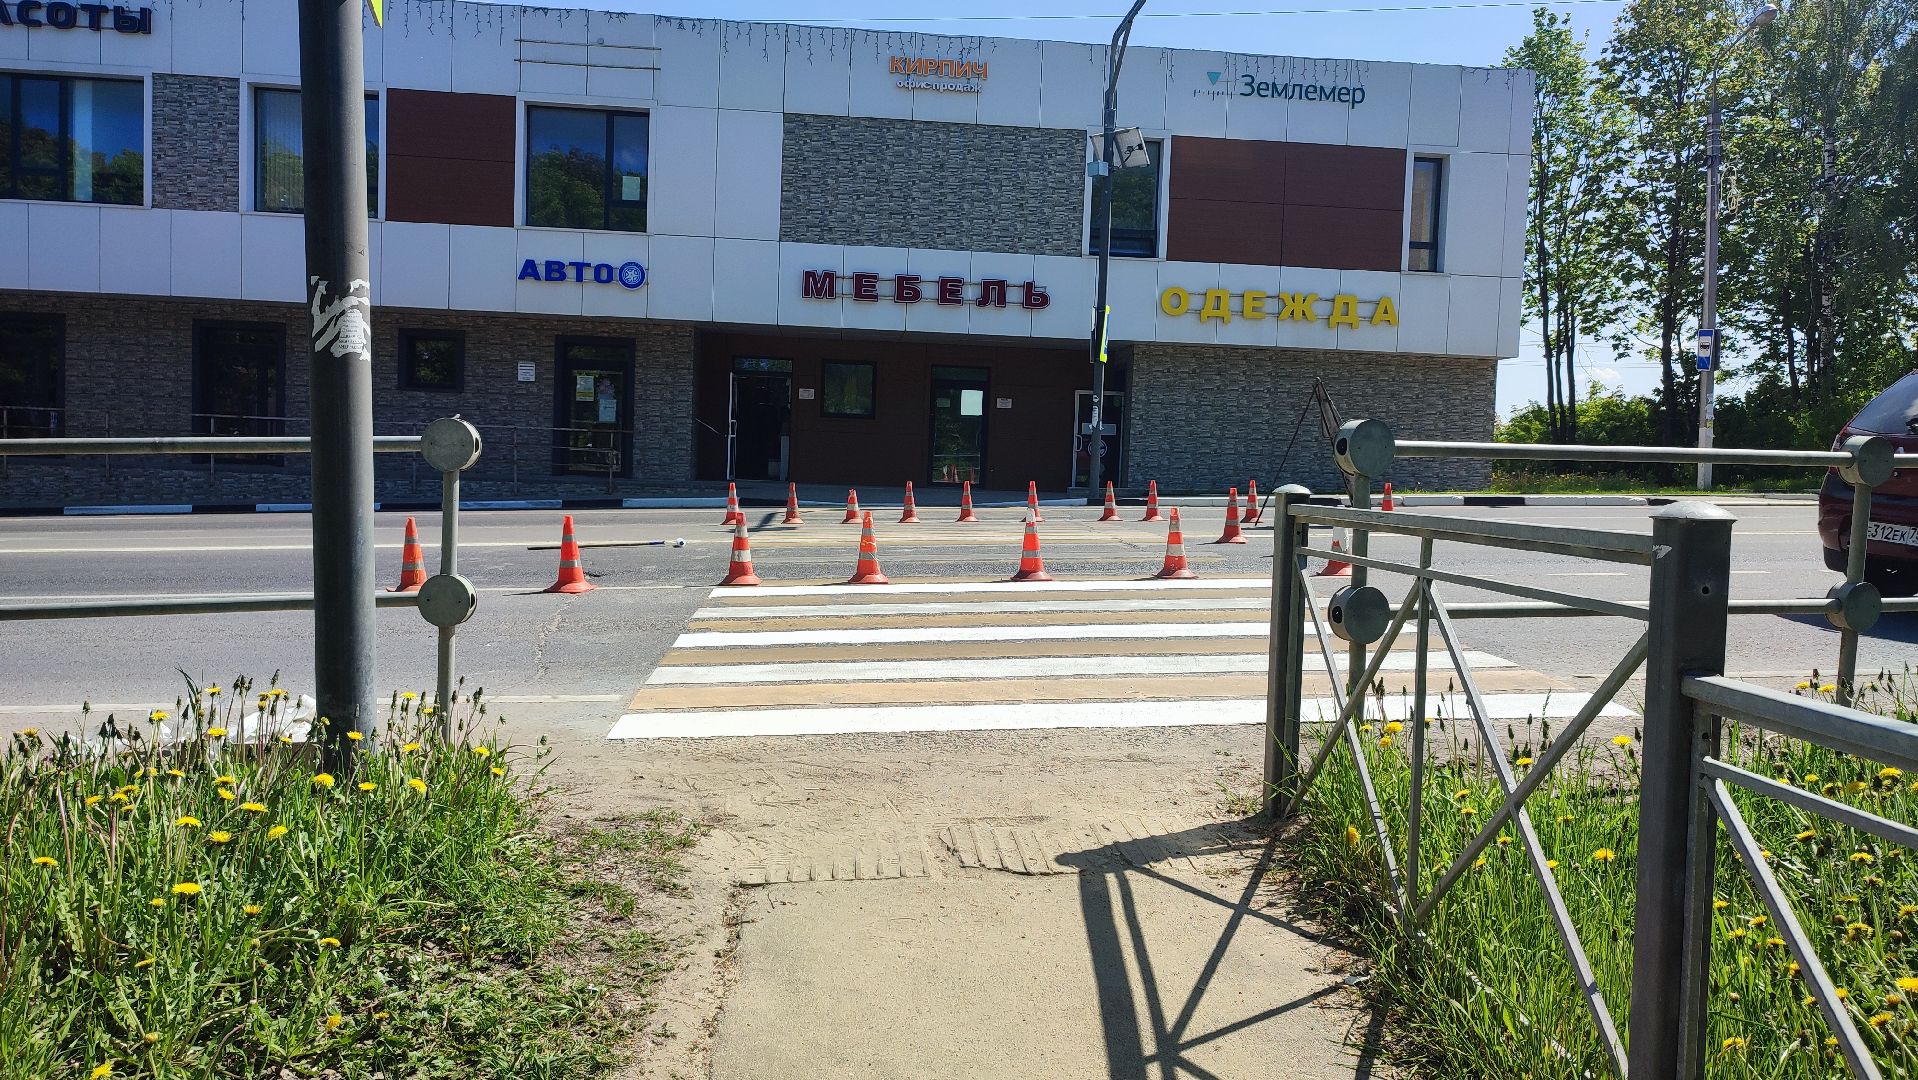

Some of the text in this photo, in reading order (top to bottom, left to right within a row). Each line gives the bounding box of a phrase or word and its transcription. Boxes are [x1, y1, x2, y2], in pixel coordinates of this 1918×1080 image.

[889, 55, 988, 80] КИРПИЧ
[896, 78, 982, 93] офис продаж
[1240, 74, 1366, 109] Землемер
[518, 259, 614, 283] АВТО
[801, 269, 1051, 310] МЕБЕЛЬ
[1161, 287, 1399, 329] ОДЕЖДА
